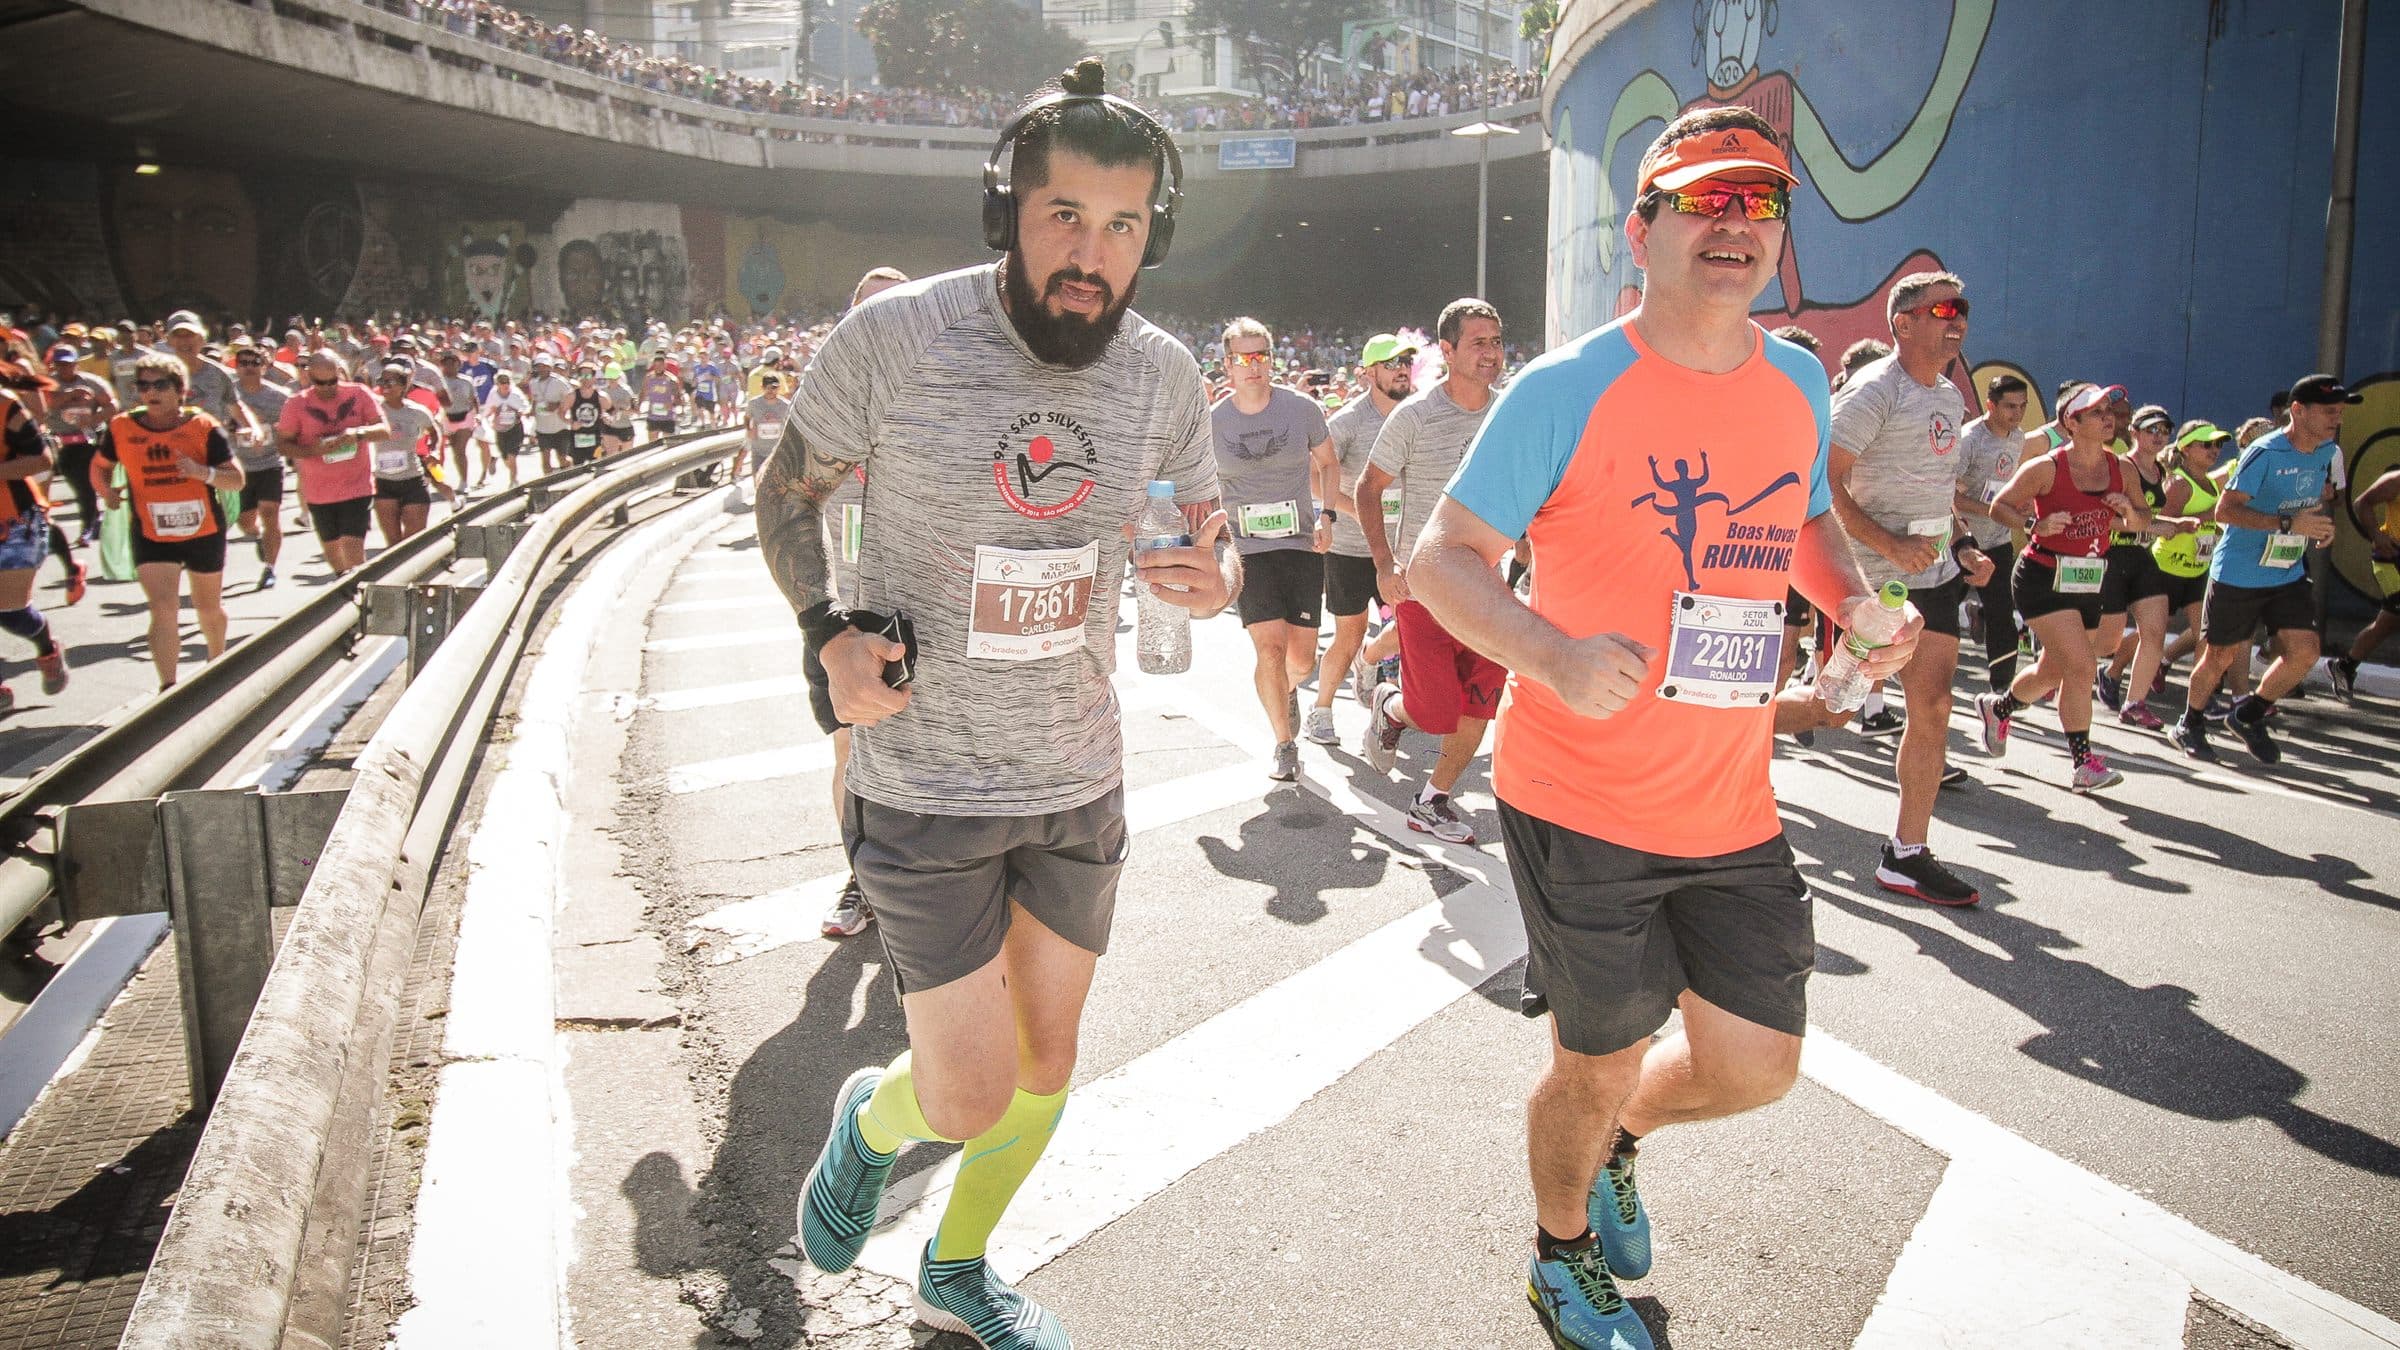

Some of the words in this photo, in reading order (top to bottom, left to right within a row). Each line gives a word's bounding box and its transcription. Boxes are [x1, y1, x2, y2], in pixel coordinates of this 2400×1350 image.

[1010, 412, 1041, 434] SÃO
[1047, 412, 1098, 465] SILVESTRE
[1257, 515, 1282, 528] 4314
[1726, 522, 1764, 540] Boas
[1766, 524, 1798, 543] Novas
[1702, 544, 1793, 572] RUNNING
[2073, 568, 2095, 580] 1520
[999, 582, 1075, 623] 17561
[1742, 610, 1769, 619] SETOR
[1021, 621, 1057, 636] CARLOS
[1743, 618, 1766, 628] AZUL
[1692, 632, 1767, 670] 22031
[1709, 670, 1748, 681] RONALDO
[1683, 689, 1718, 700] bradesco
